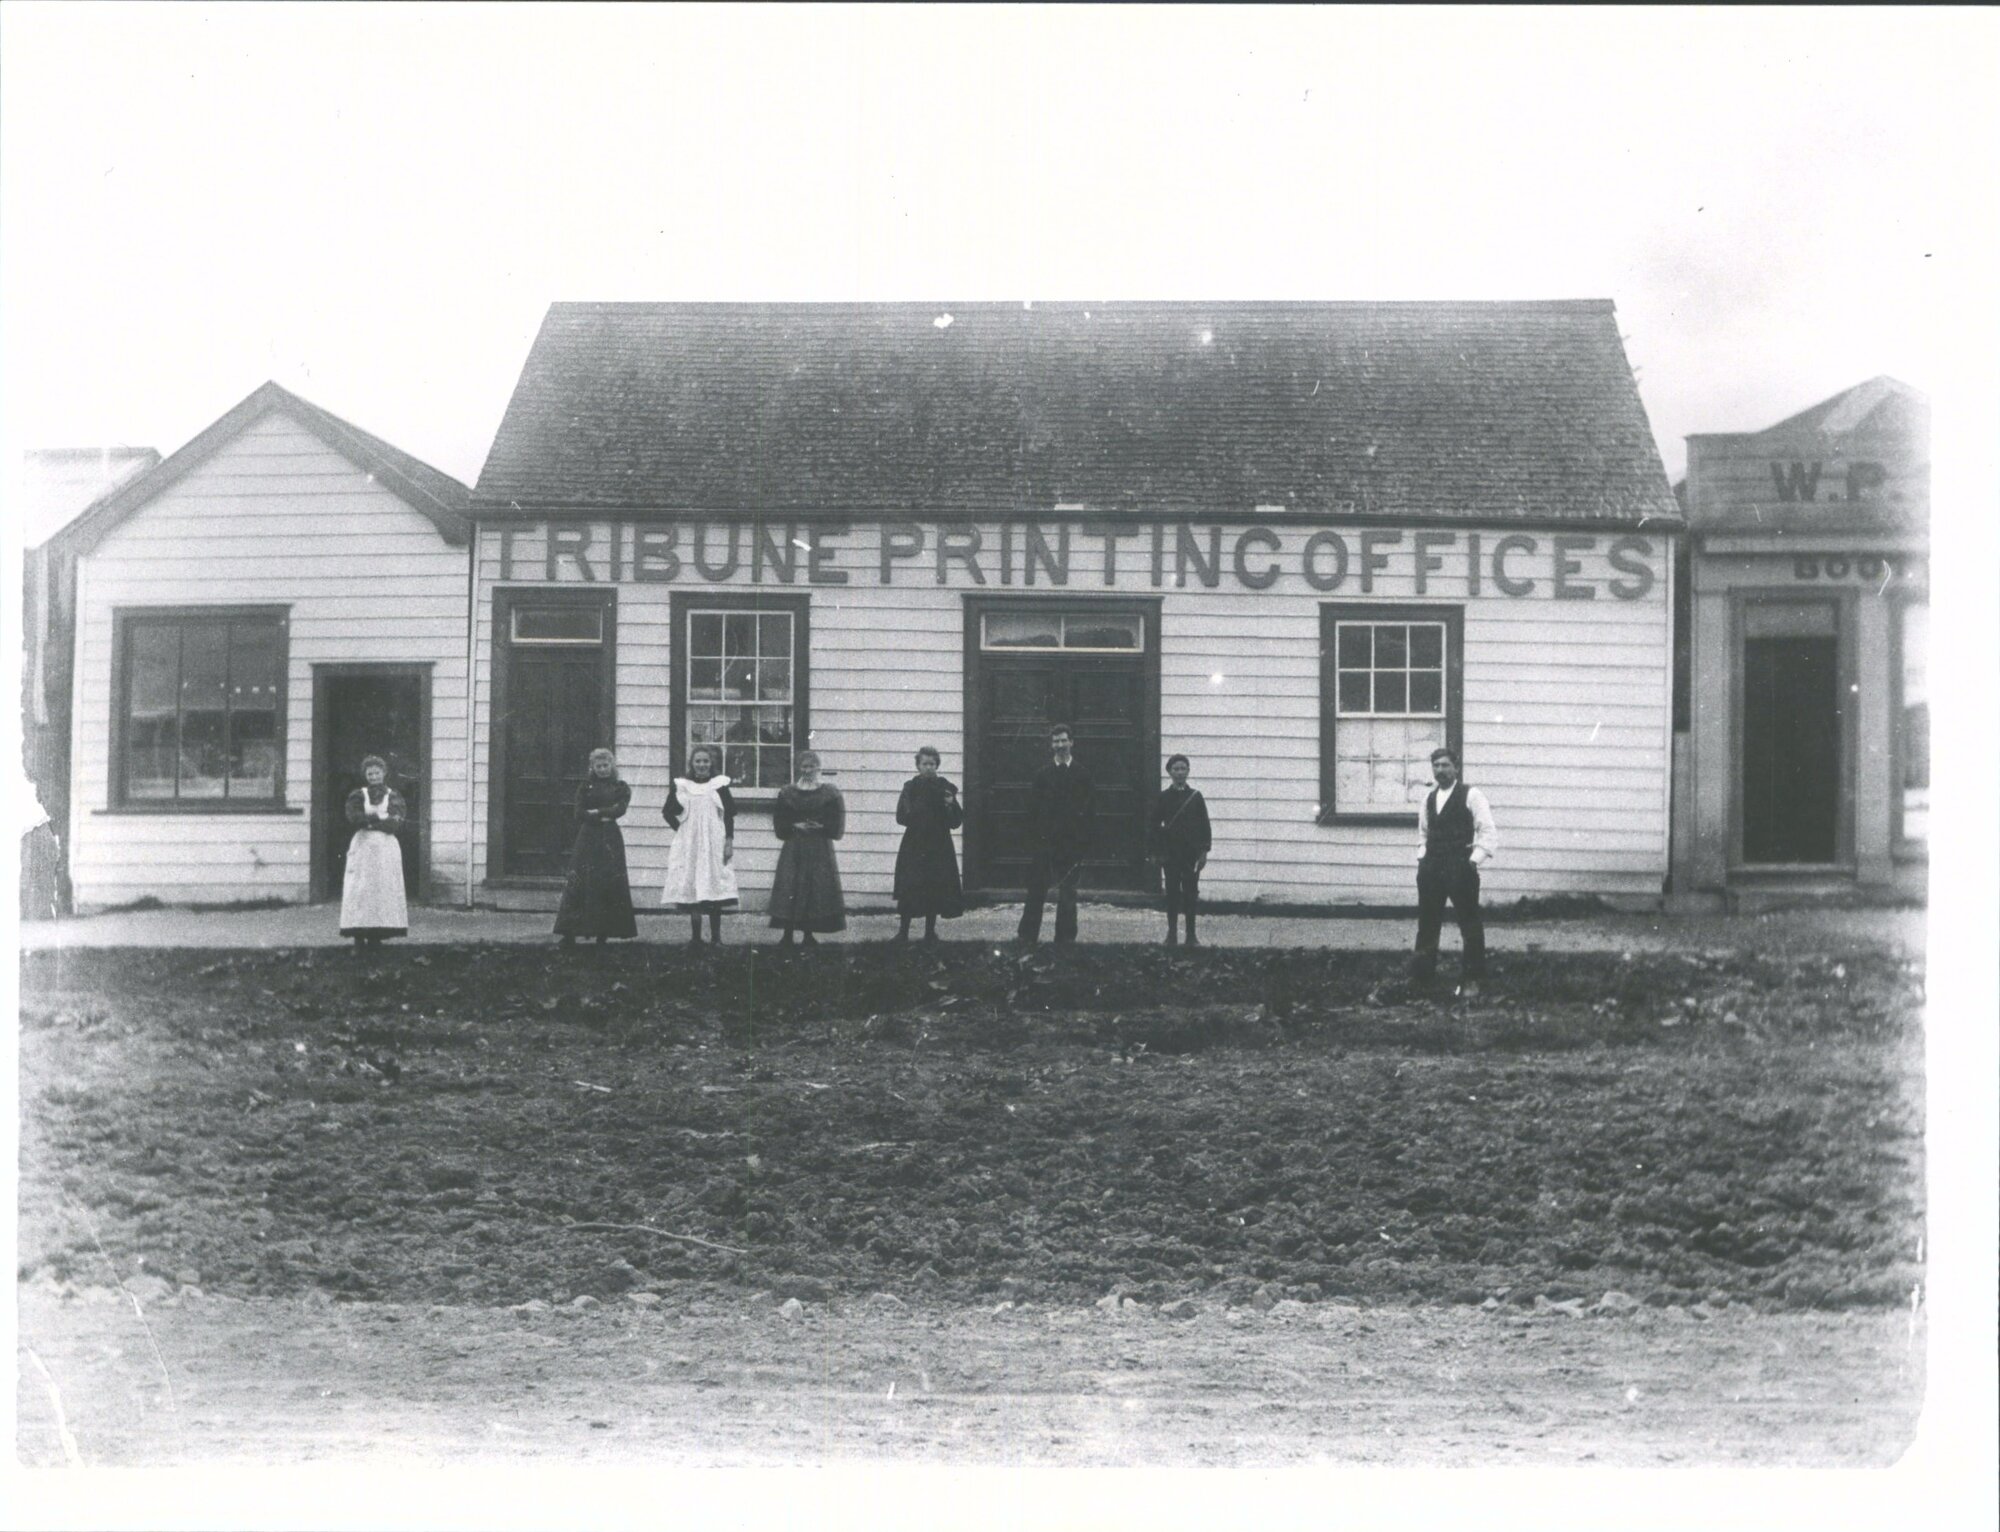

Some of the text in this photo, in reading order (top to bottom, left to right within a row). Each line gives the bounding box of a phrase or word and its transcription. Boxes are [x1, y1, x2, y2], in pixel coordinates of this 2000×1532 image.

[482, 520, 1656, 602] TRIBUNE PRINTING OFFICES
